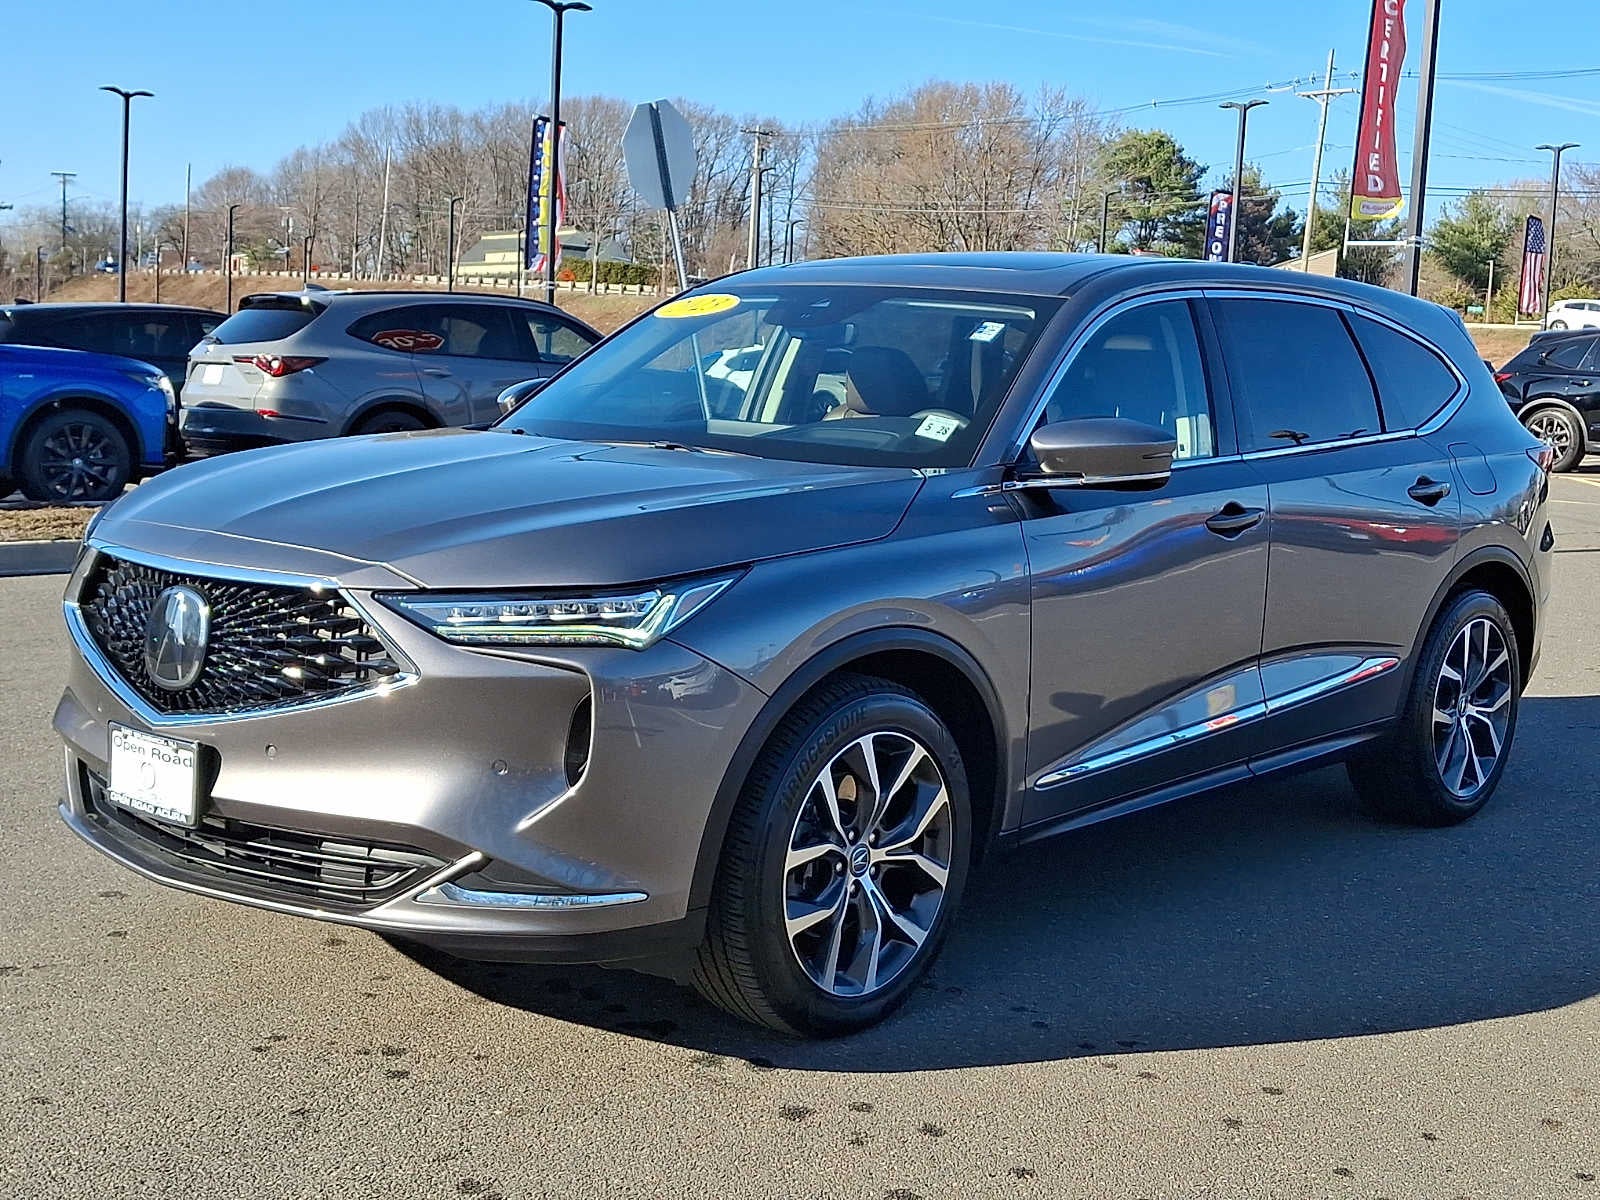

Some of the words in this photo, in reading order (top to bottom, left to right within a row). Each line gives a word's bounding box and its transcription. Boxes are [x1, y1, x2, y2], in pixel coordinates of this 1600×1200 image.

[1367, 0, 1399, 193] CERTIFIED
[1214, 200, 1228, 239] PRE
[113, 735, 145, 755] Open
[151, 747, 193, 768] Road
[131, 798, 155, 814] ROAD
[154, 806, 187, 823] ACURA
